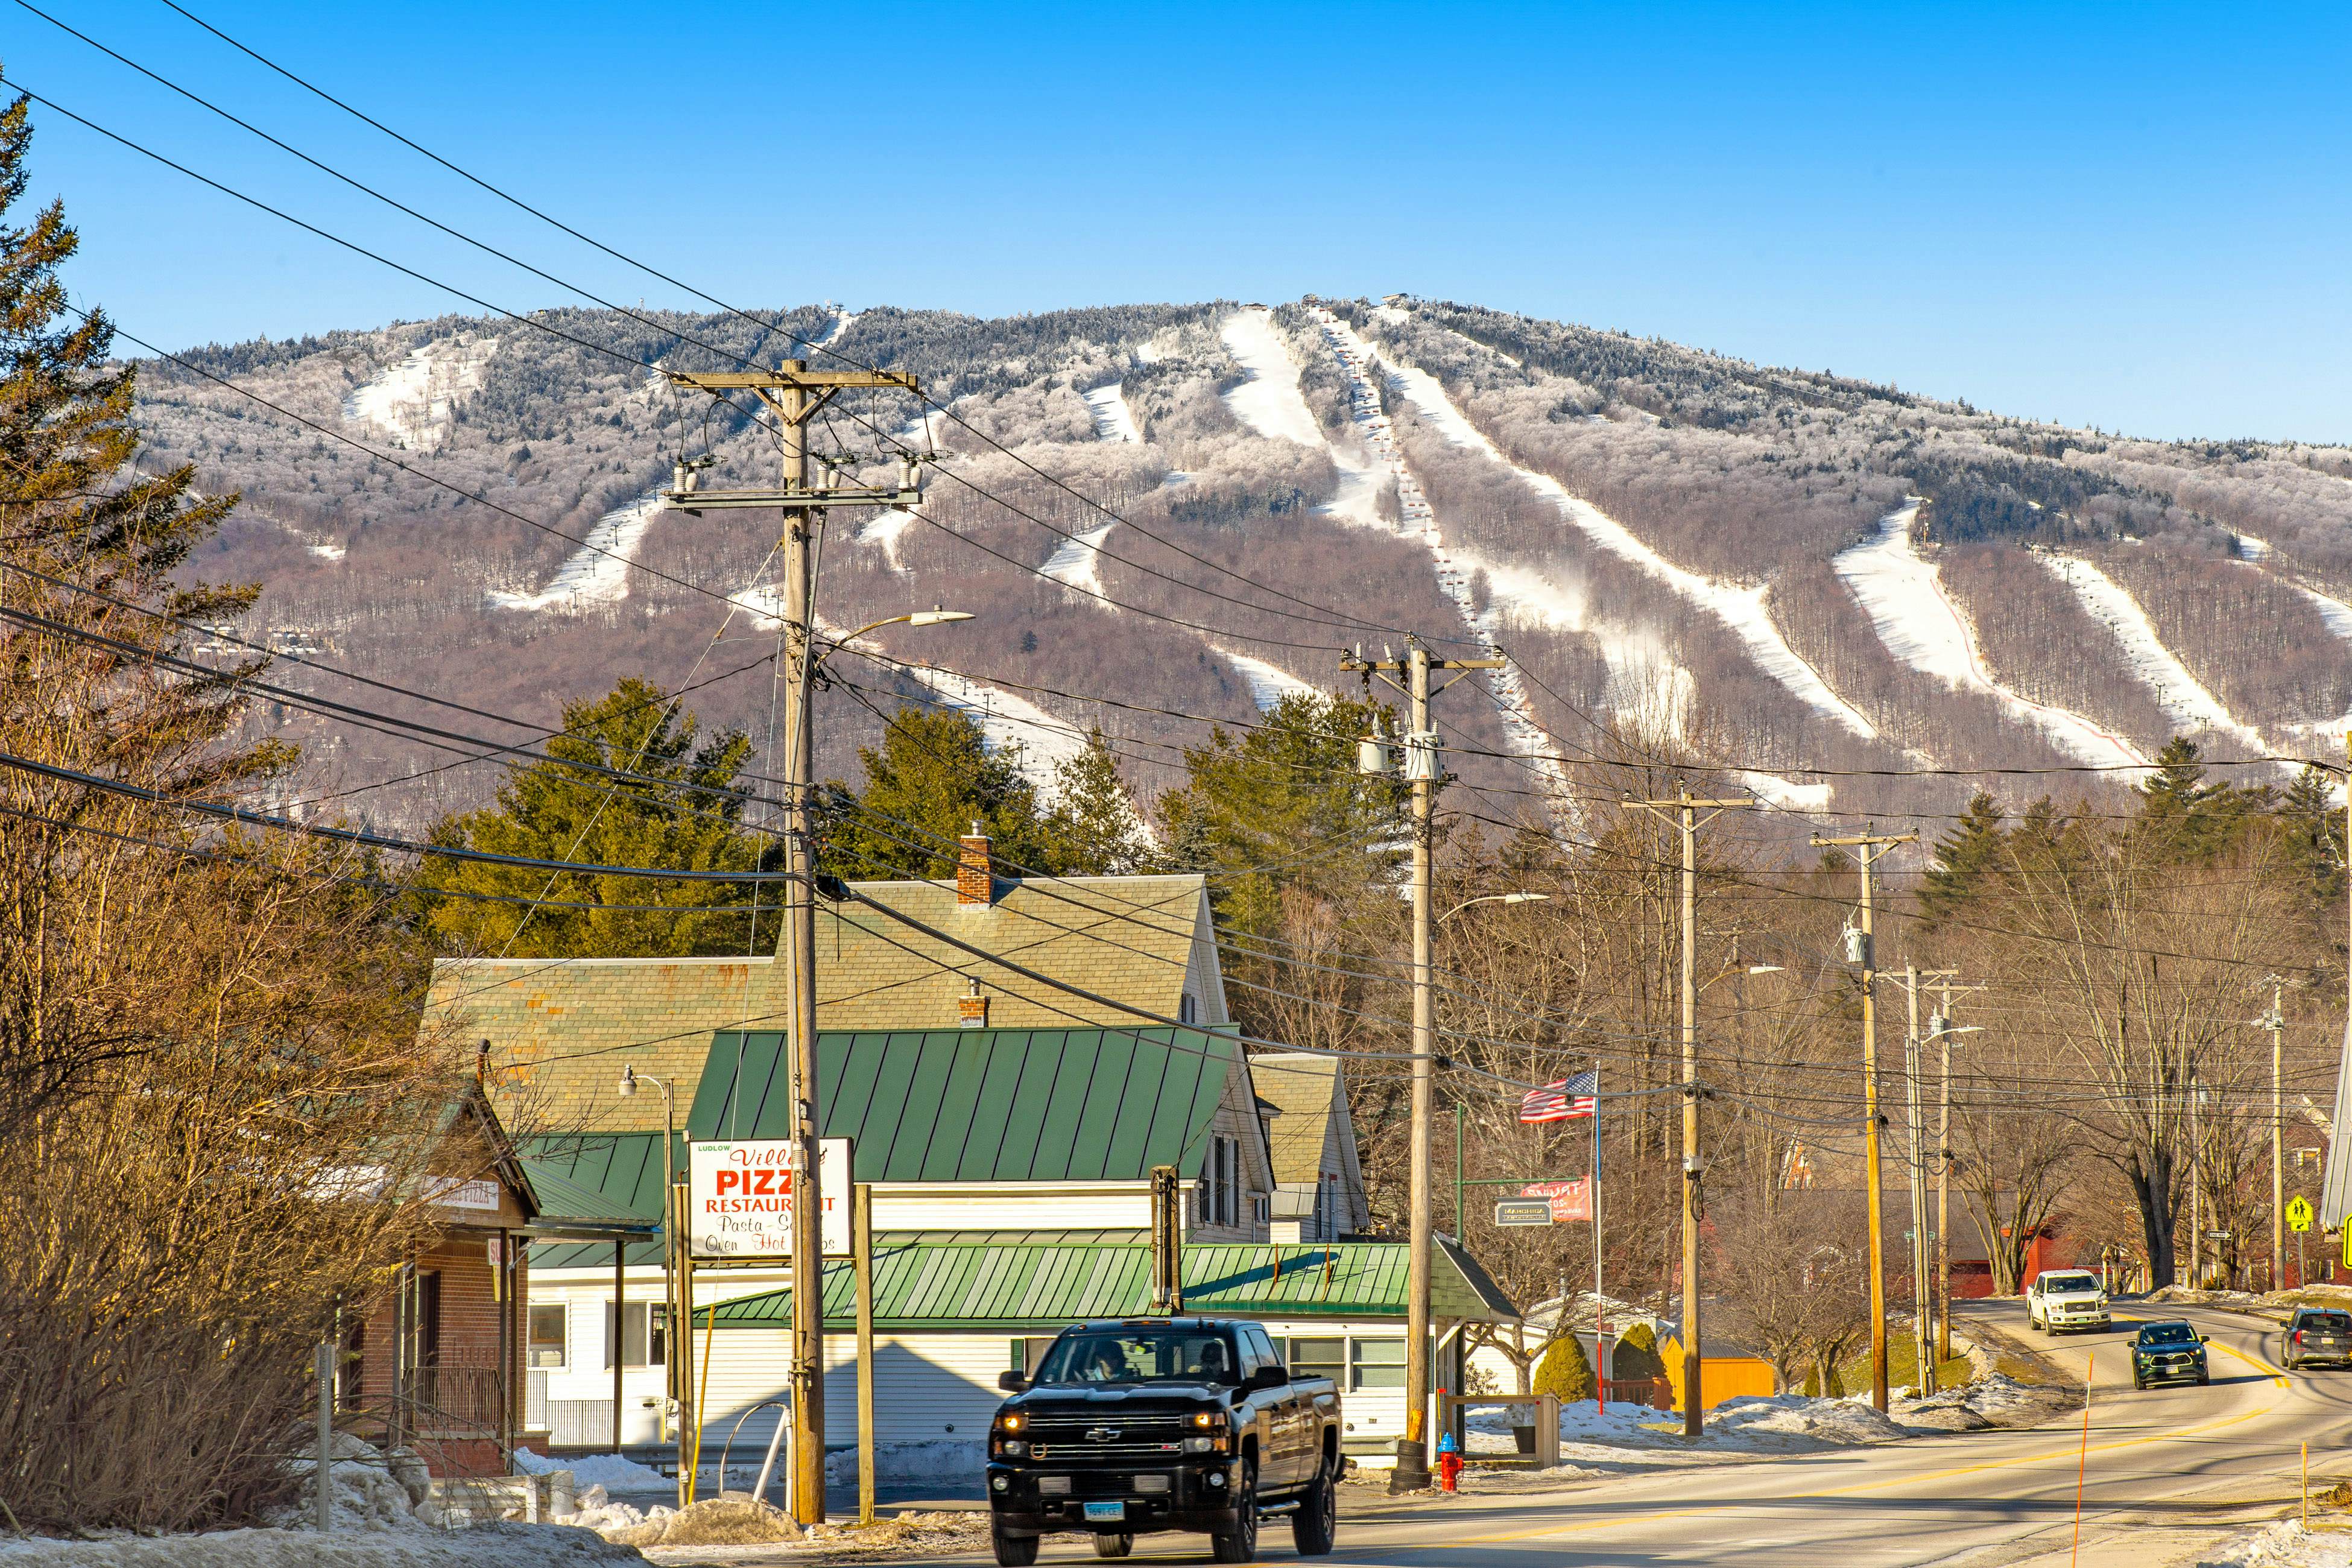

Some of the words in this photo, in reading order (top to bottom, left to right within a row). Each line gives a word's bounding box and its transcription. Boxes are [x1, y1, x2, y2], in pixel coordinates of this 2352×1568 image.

[730, 1149, 826, 1166] Ville
[716, 1170, 824, 1196] PIZZ
[464, 1181, 490, 1204] PIZZA
[706, 1197, 836, 1212] RESTAURT
[716, 1215, 763, 1232] Pasta
[490, 1242, 511, 1262] SUS
[705, 1234, 738, 1252] Oven
[751, 1234, 786, 1251] Hot
